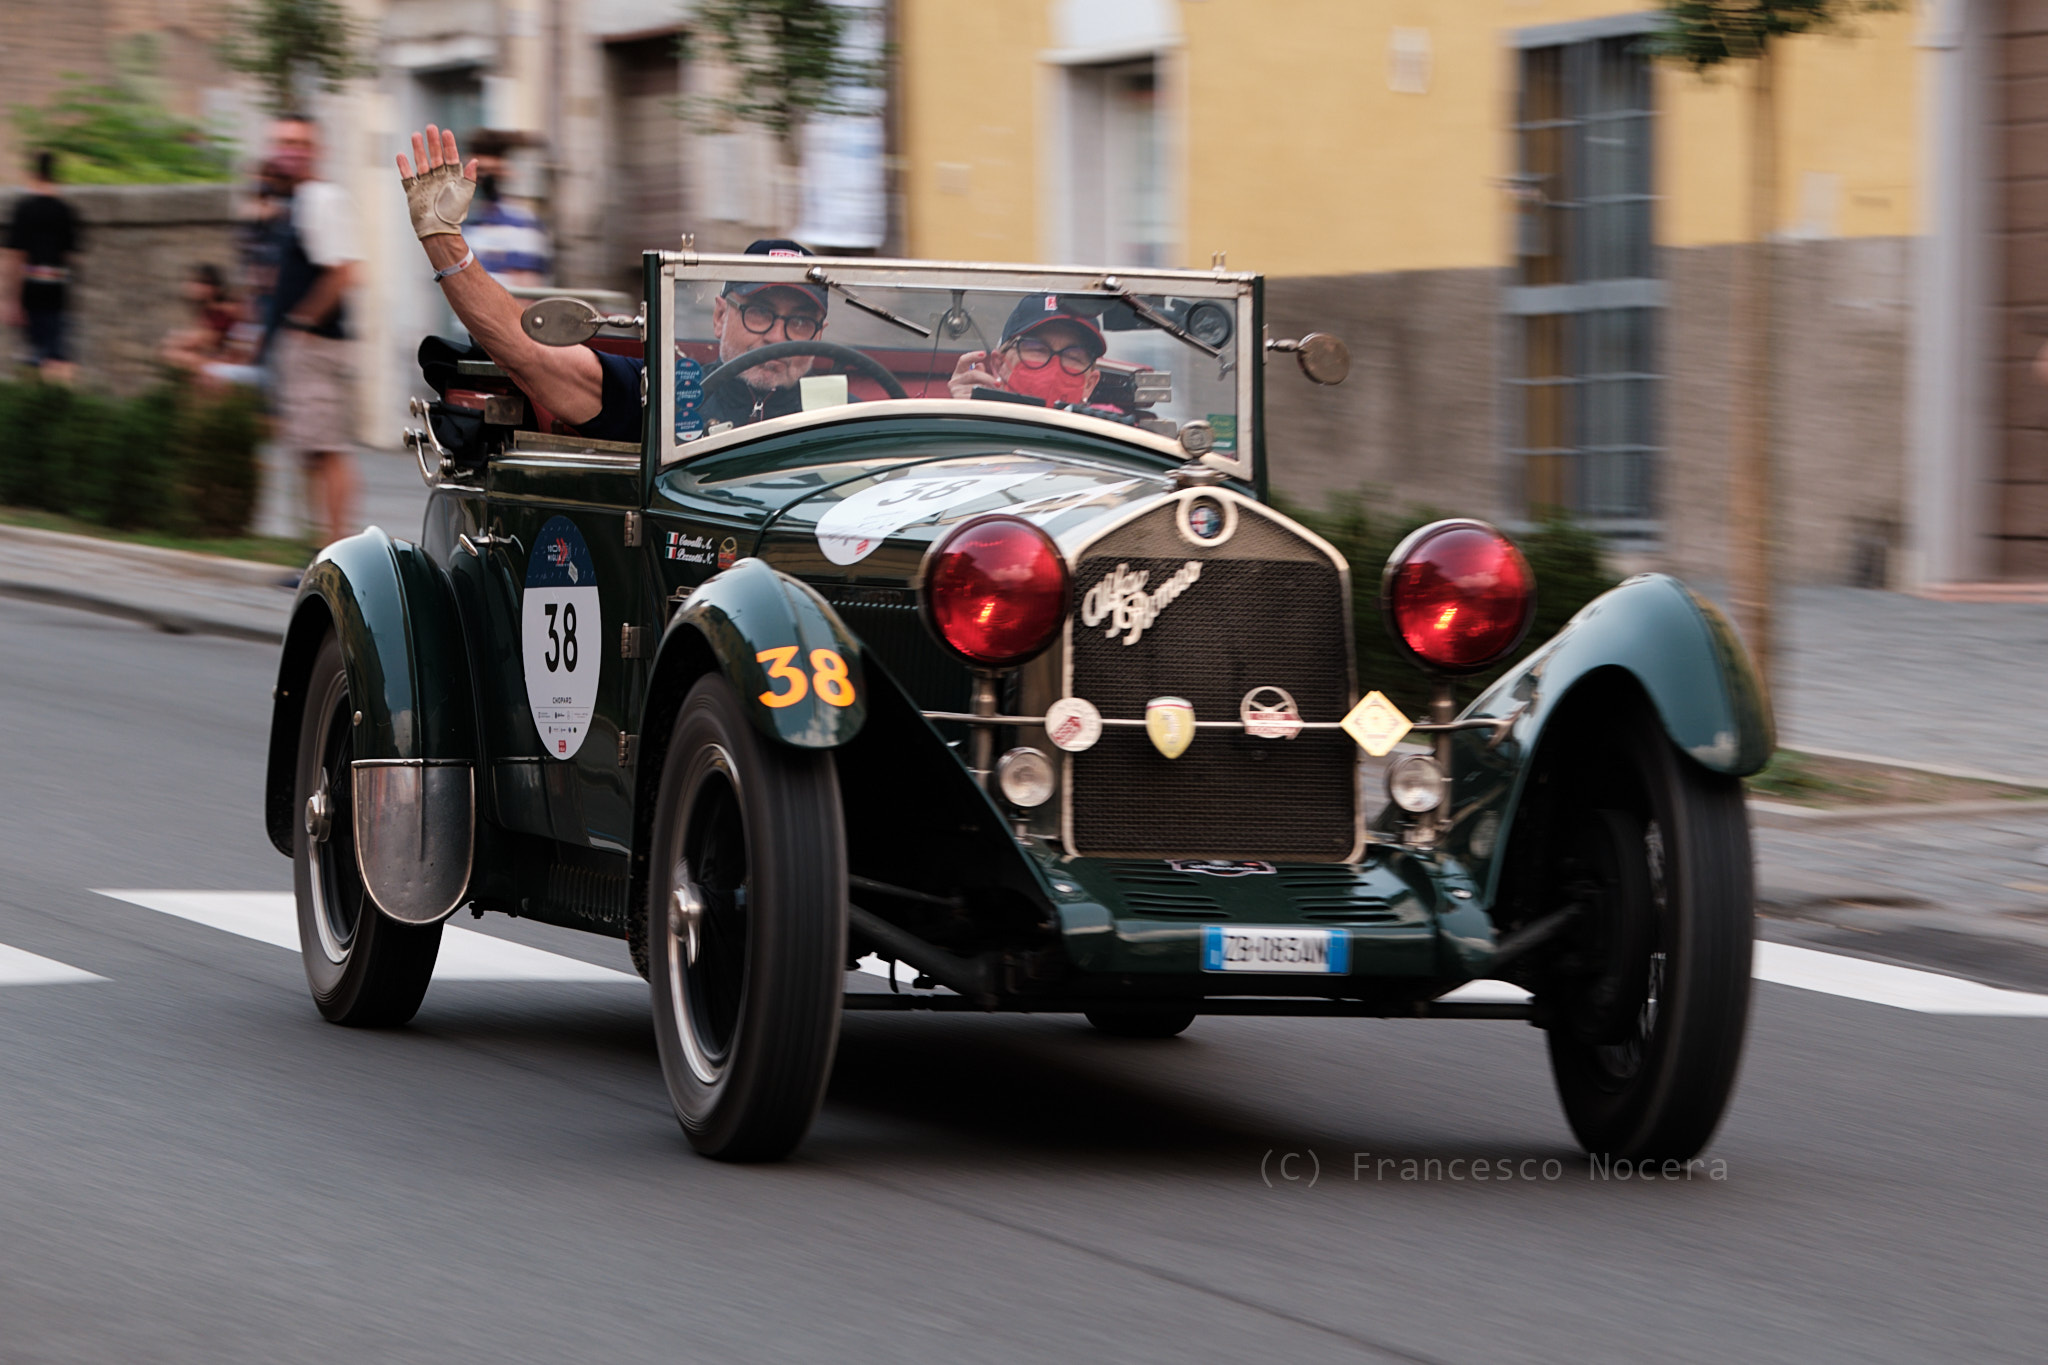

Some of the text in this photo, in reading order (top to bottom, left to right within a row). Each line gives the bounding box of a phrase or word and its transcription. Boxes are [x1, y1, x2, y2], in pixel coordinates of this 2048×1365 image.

[878, 479, 981, 506] 38
[544, 602, 578, 673] 38
[756, 645, 856, 708] 38
